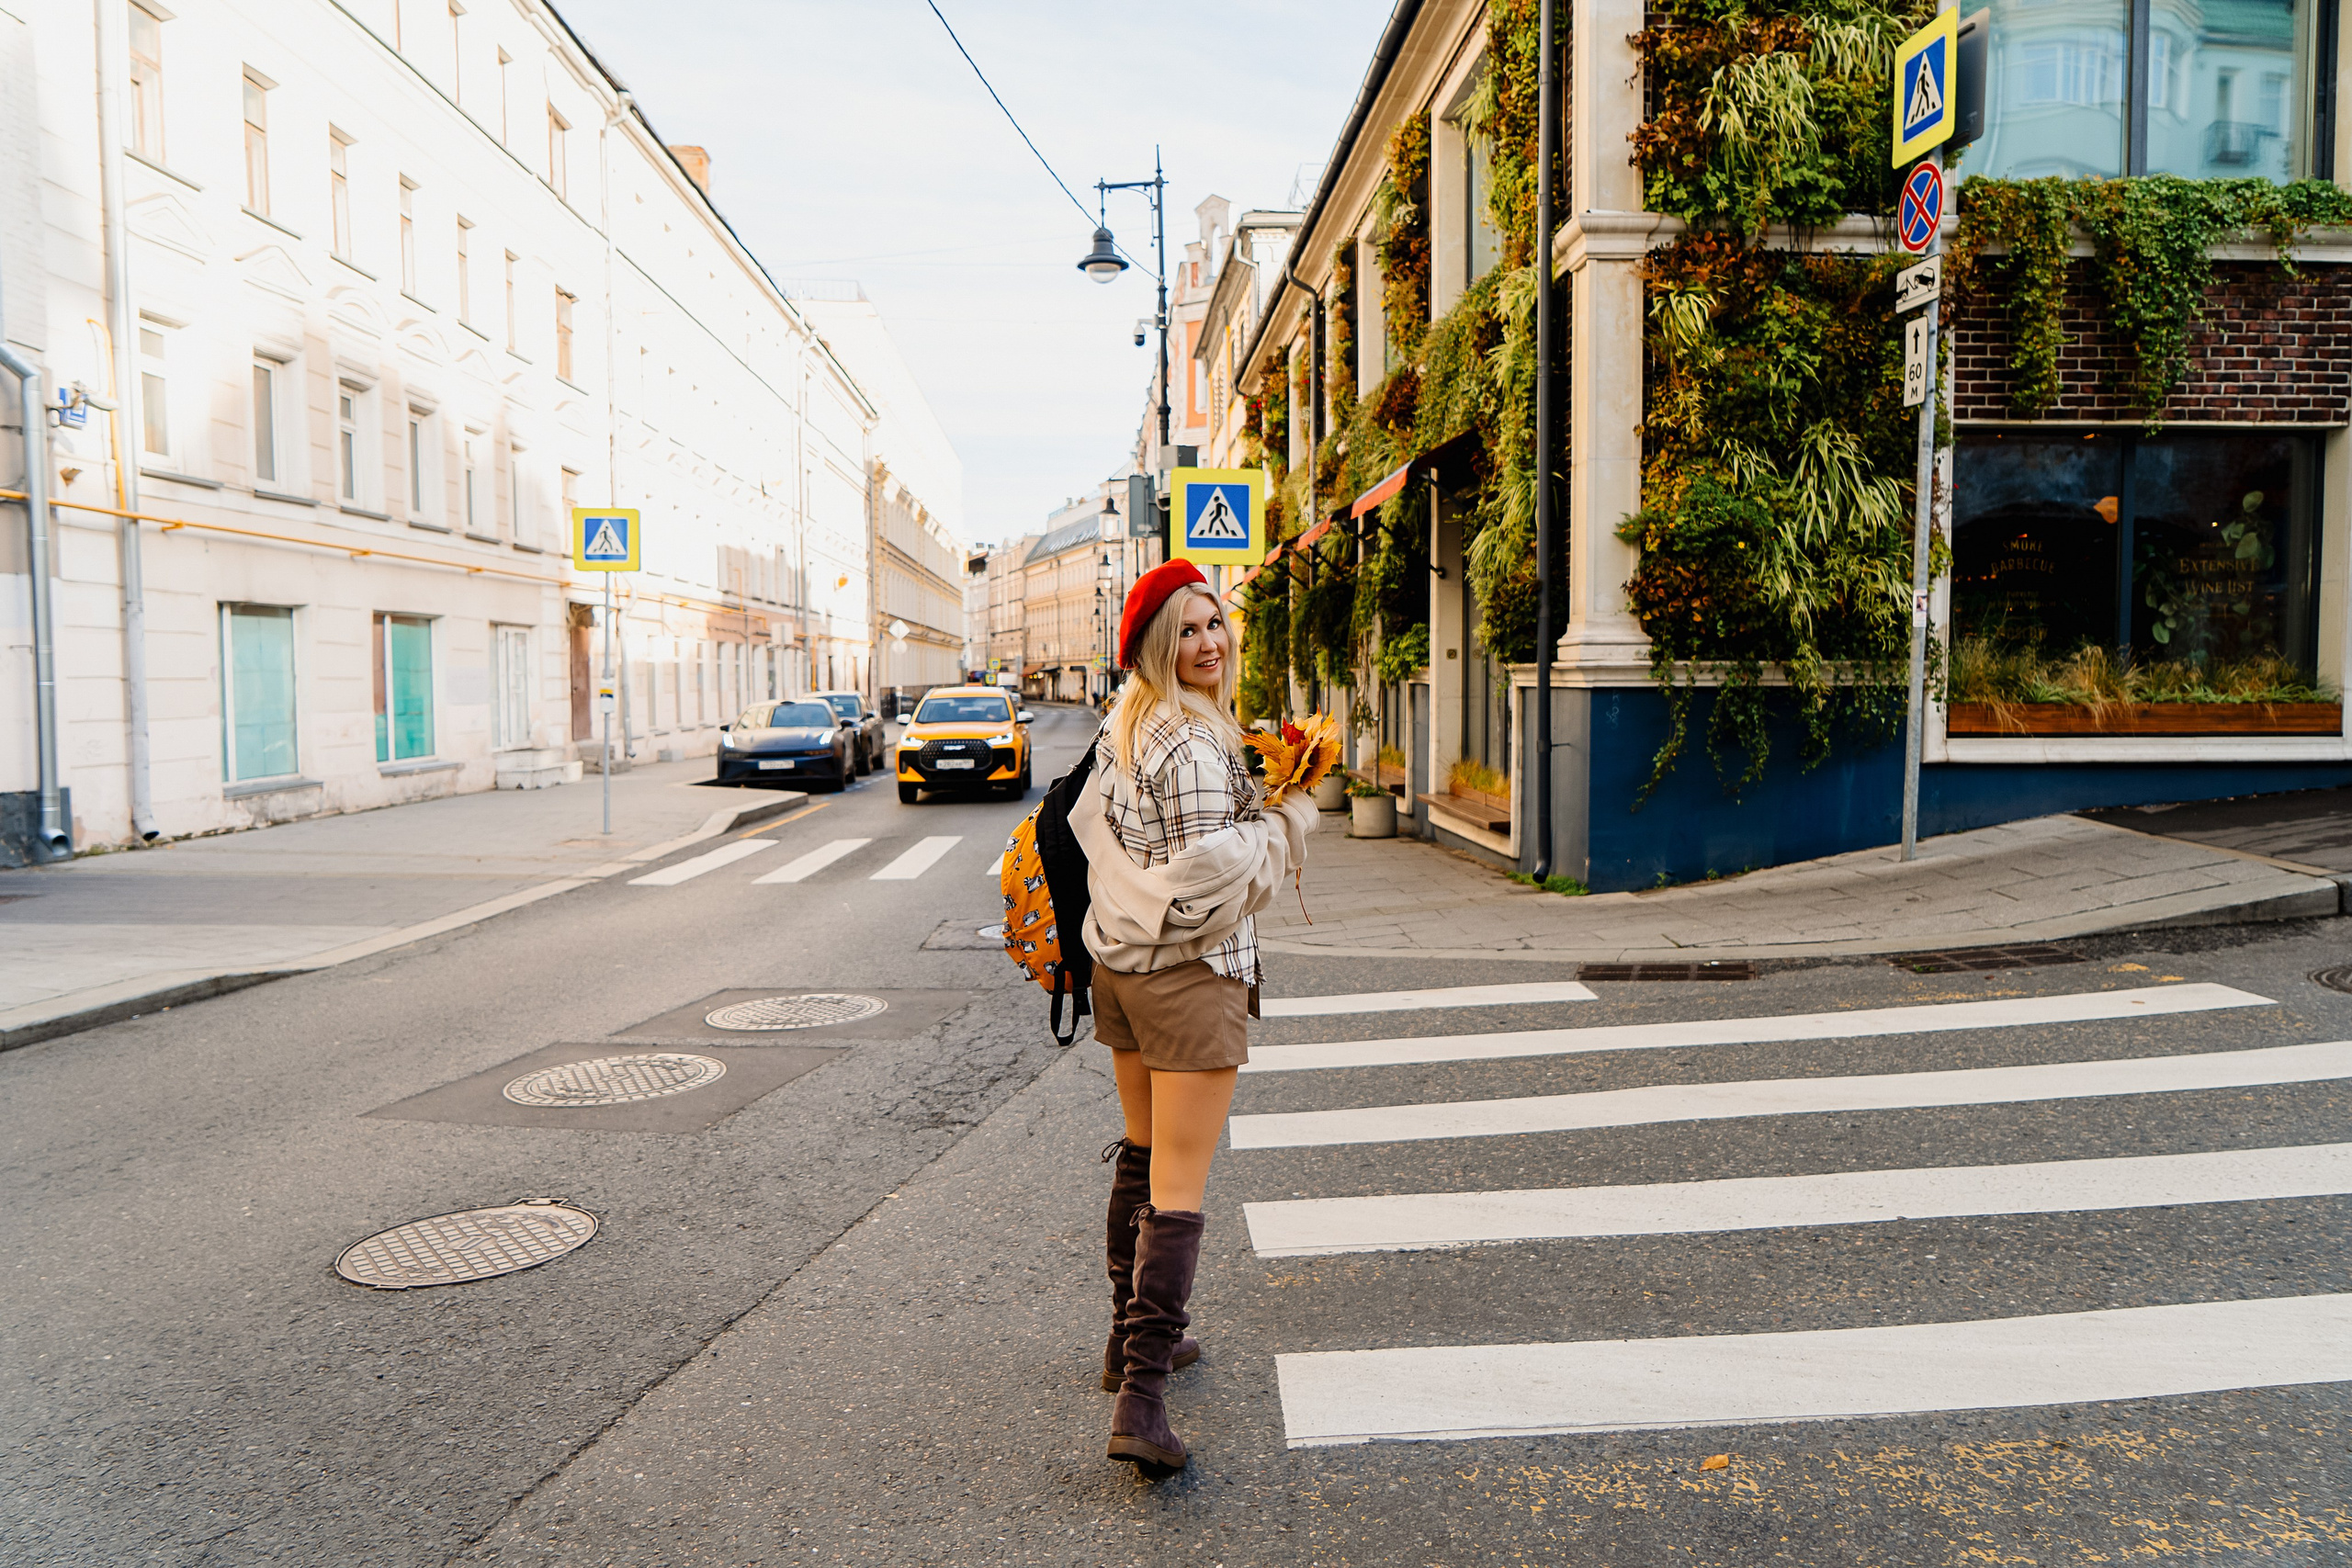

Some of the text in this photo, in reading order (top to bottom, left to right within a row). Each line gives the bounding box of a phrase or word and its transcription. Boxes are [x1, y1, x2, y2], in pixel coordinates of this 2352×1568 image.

[1908, 362, 1922, 381] 60
[2002, 538, 2044, 553] SMOKE
[1990, 557, 2057, 575] BARBECUE
[2178, 557, 2258, 574] EXTENSIVE
[2184, 578, 2256, 597] WINE LIST
